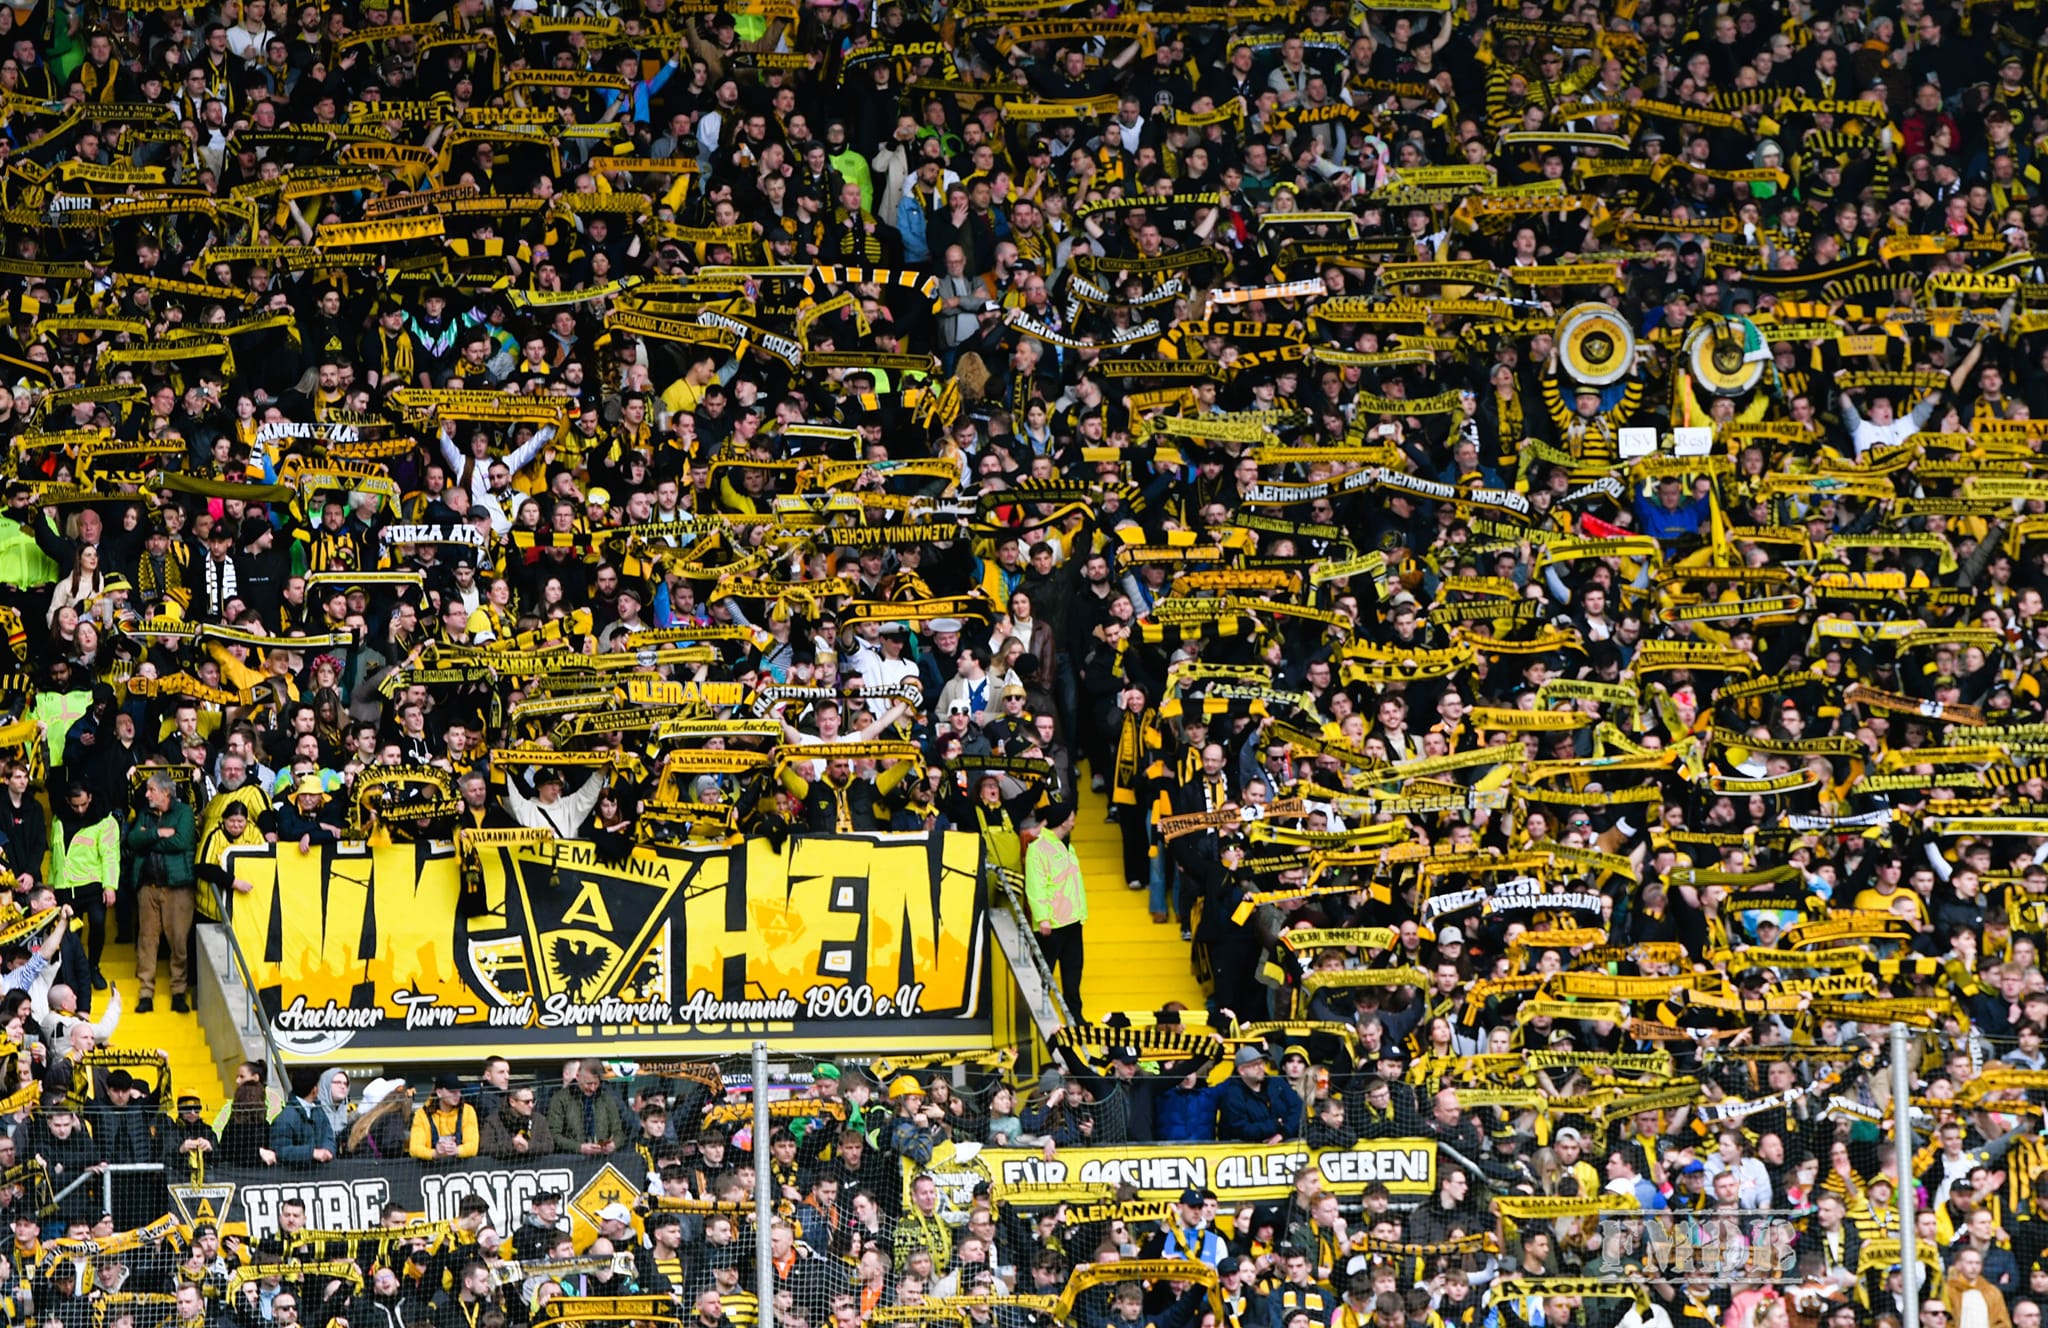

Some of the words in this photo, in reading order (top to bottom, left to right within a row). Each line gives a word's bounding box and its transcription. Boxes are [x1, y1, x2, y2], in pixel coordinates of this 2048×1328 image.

[1020, 23, 1137, 37] ALEMANNIA
[512, 71, 574, 83] EMANNIA
[1299, 105, 1361, 123] AACHEN
[1777, 98, 1887, 119] AACHEN
[343, 146, 438, 171] ALEMANNIA
[374, 193, 435, 210] ALEMANNIA
[467, 274, 498, 282] VEREIN
[1510, 267, 1564, 278] lemannia
[1567, 267, 1613, 278] Aachen
[658, 322, 694, 339] AACHEN
[1101, 362, 1168, 375] ALEMANNIA
[1170, 362, 1215, 376] AACHEN
[502, 397, 535, 405] MANNIA
[1245, 483, 1325, 501] ALEMANNIA
[1377, 470, 1456, 497] ALEMANNIA
[1470, 490, 1529, 513] AACHEN
[384, 524, 440, 543] FORZA
[829, 527, 881, 544] AACHEN
[885, 527, 956, 543] ALEMANNIA
[1677, 603, 1736, 621] ALEMANNIA
[540, 675, 602, 688] Alemannia
[606, 672, 653, 683] Aachen
[630, 682, 741, 705] ALEMANNIA
[751, 686, 835, 720] ALEMANNIA
[857, 684, 922, 709] AACHEN
[589, 713, 639, 724] ALEMANNIA
[593, 718, 644, 730] AUFSTEIGER
[666, 722, 728, 735] Alemannia
[732, 721, 781, 735] Aachen
[1714, 734, 1781, 750] ALEMANNIA
[1783, 739, 1835, 750] AACHEN
[498, 752, 563, 761] EMANNIA
[677, 757, 733, 768] ALEMANNIA
[1202, 810, 1234, 825] FUCHS
[471, 831, 516, 843] ALEMANNIA
[560, 880, 615, 933] A
[1809, 951, 1855, 962] AACHEN
[279, 995, 385, 1031] Aachener
[392, 991, 477, 1032] Turn-
[489, 1002, 534, 1028] und
[539, 994, 673, 1029] Sportverein
[679, 990, 799, 1022] Alemannia
[805, 983, 873, 1018] 1900
[875, 983, 925, 1018] e.V.
[721, 1073, 752, 1085] DITION
[1003, 1157, 1066, 1191] FÜR
[1080, 1155, 1206, 1193] AACHEN
[1216, 1150, 1309, 1190] ALLES
[1318, 1147, 1431, 1186] GEBEN!
[1064, 1201, 1170, 1228] ALEMANNI
[562, 1302, 613, 1315] ALEMANNIA
[616, 1302, 652, 1314] AACHEN
